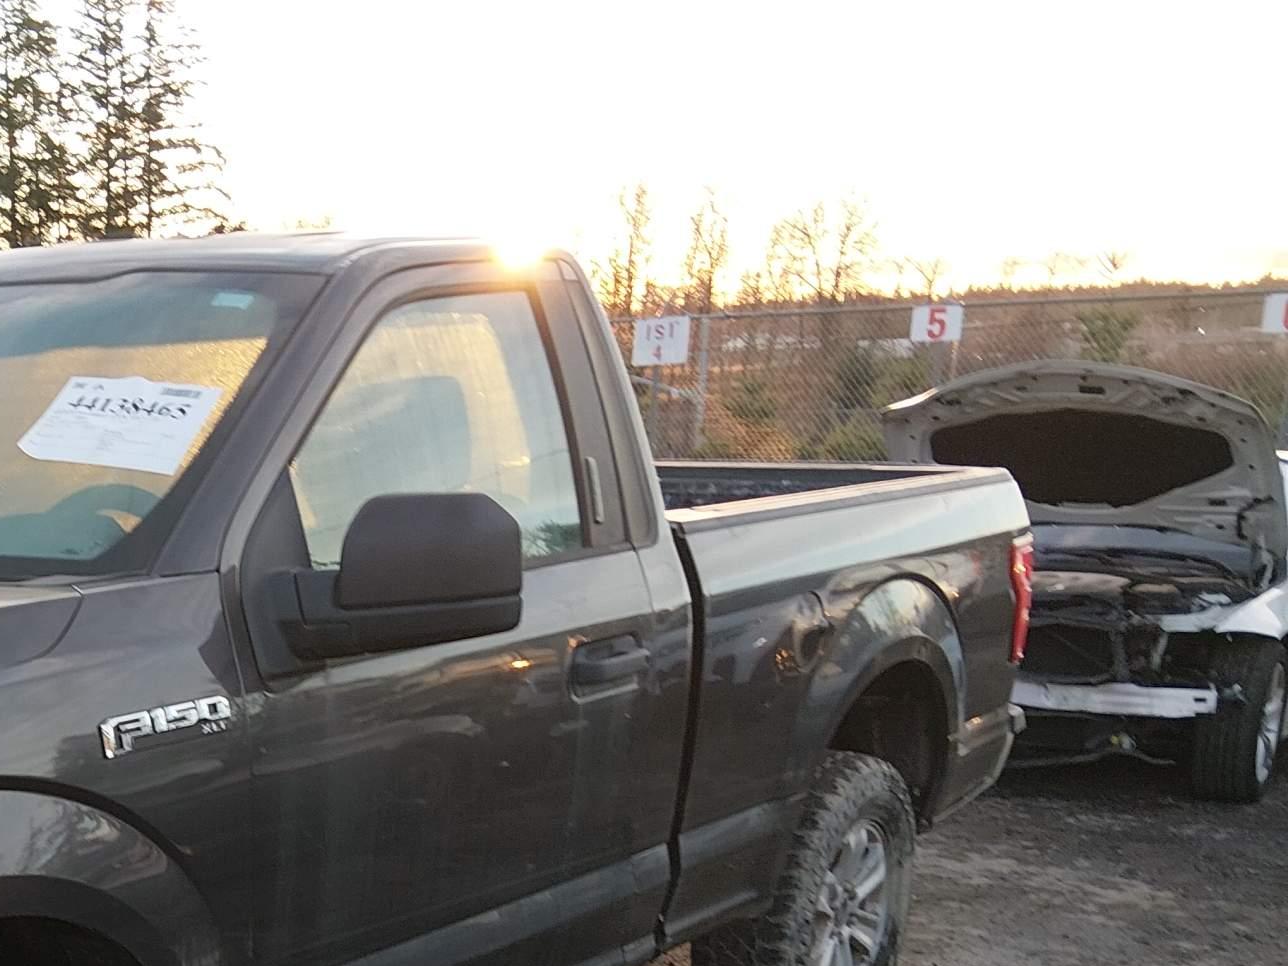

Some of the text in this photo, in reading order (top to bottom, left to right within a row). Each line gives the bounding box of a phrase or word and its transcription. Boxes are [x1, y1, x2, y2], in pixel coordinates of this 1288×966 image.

[927, 308, 946, 340] 5
[68, 395, 191, 420] 44138465
[200, 719, 228, 735] XLT
